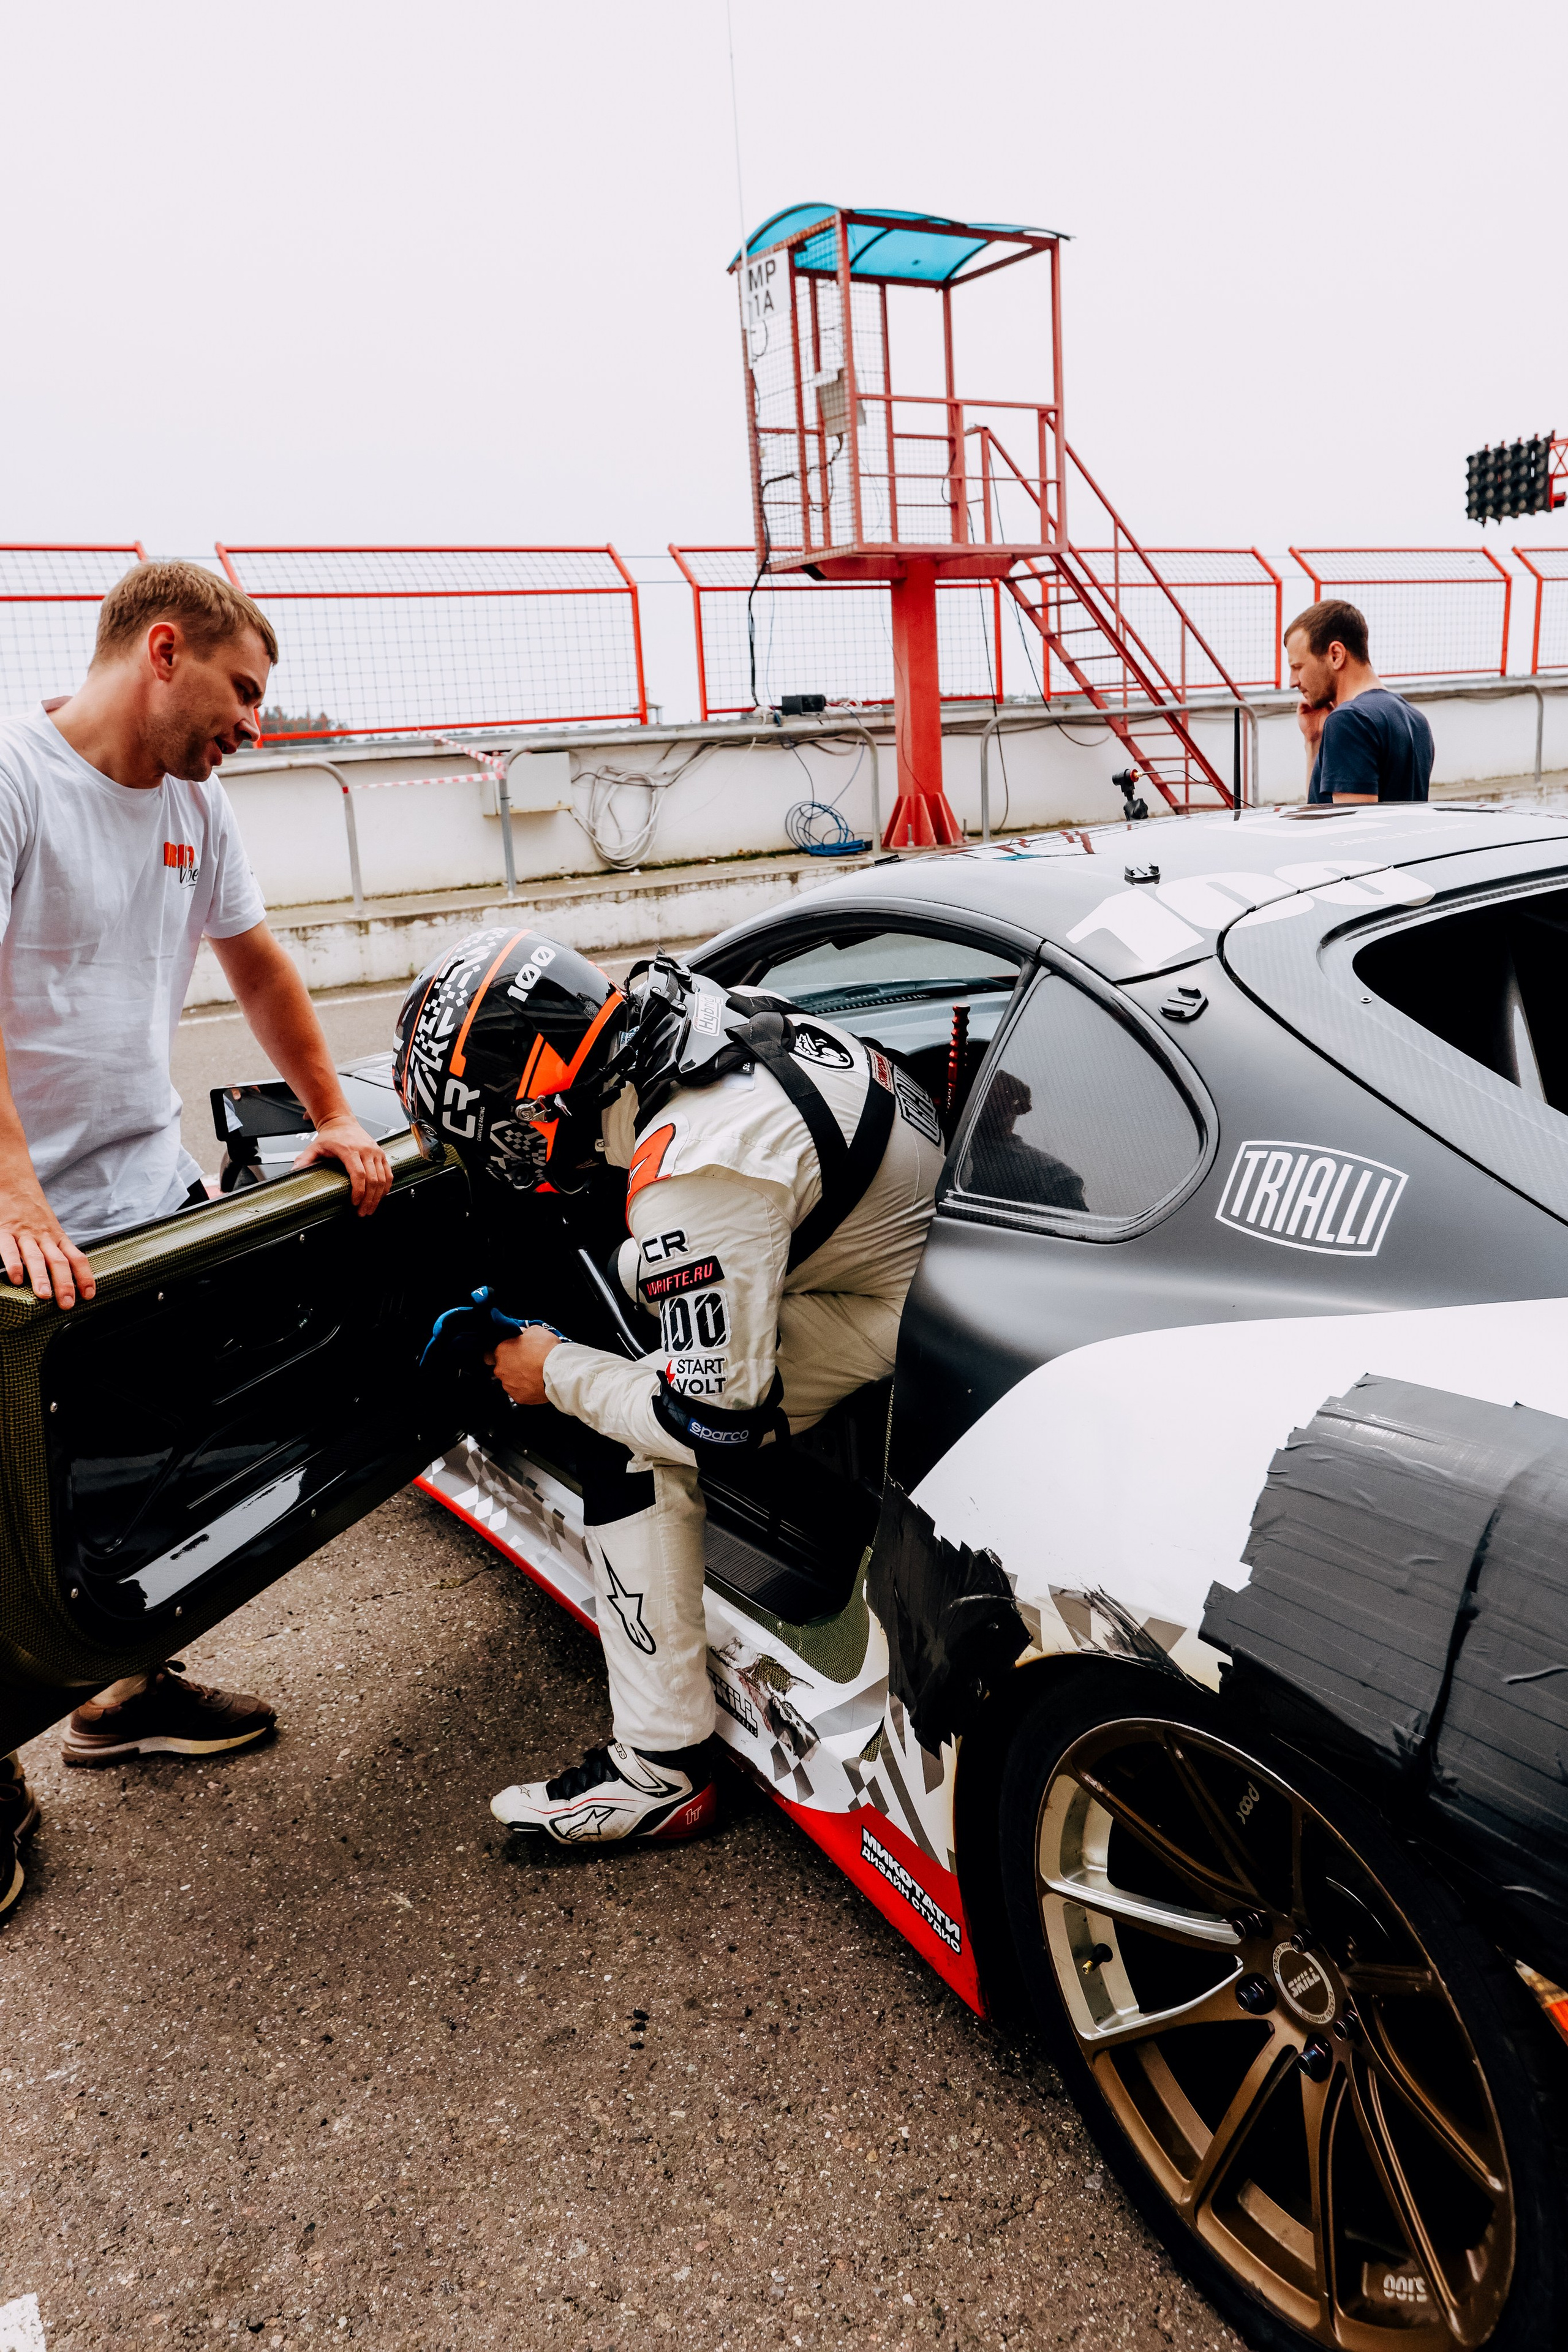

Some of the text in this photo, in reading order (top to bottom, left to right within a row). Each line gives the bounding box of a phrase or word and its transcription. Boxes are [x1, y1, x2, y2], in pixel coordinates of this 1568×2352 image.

[748, 260, 775, 292] MP
[1329, 831, 1415, 847] CARVILLE
[1065, 860, 1436, 968] 100
[507, 946, 556, 1002] 100
[699, 996, 718, 1030] Hybrid
[442, 1079, 480, 1138] CR
[1231, 1150, 1393, 1245] TRIALLI
[642, 1230, 688, 1264] CR
[676, 1358, 725, 1374] START
[676, 1378, 726, 1395] VOLT
[690, 1421, 749, 1442] sparco
[862, 1845, 961, 1953] ДИЗАЙН СТУДИО
[863, 1828, 960, 1940] МИКОТАТИ
[1287, 1967, 1321, 1998] SKILL
